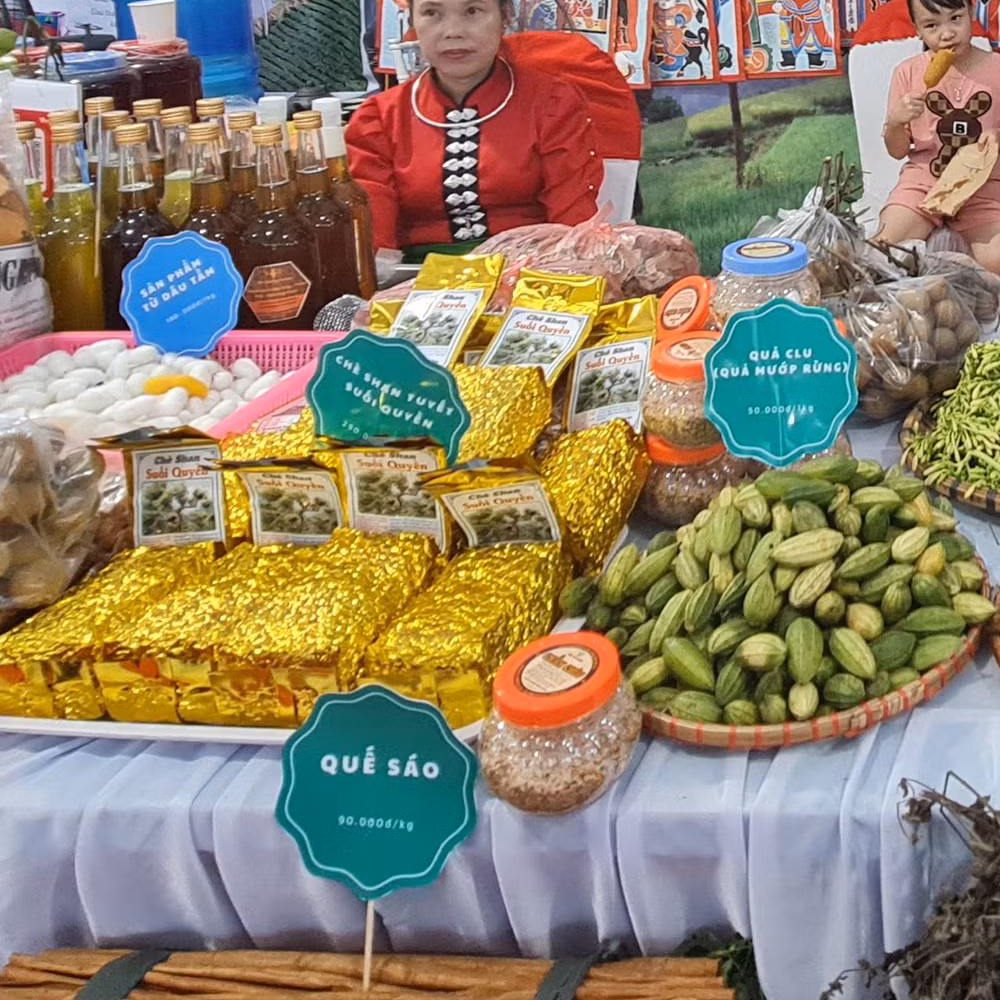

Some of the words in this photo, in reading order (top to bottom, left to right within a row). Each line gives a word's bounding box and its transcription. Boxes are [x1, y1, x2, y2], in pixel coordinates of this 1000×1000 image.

[512, 319, 539, 332] Suối
[749, 345, 781, 362] QUẢ
[785, 347, 813, 360] CLU
[713, 361, 750, 380] (QUẢ
[754, 360, 798, 377] MƯỚP
[802, 359, 849, 375] RỪNG)
[335, 355, 361, 376] CHÈ
[363, 372, 402, 398] SHAN
[407, 393, 454, 416] TUYẾT
[345, 382, 377, 408] SUỐI
[380, 404, 434, 429] QUYỀN
[320, 744, 376, 776] QUẾ
[387, 752, 440, 780] SÁO
